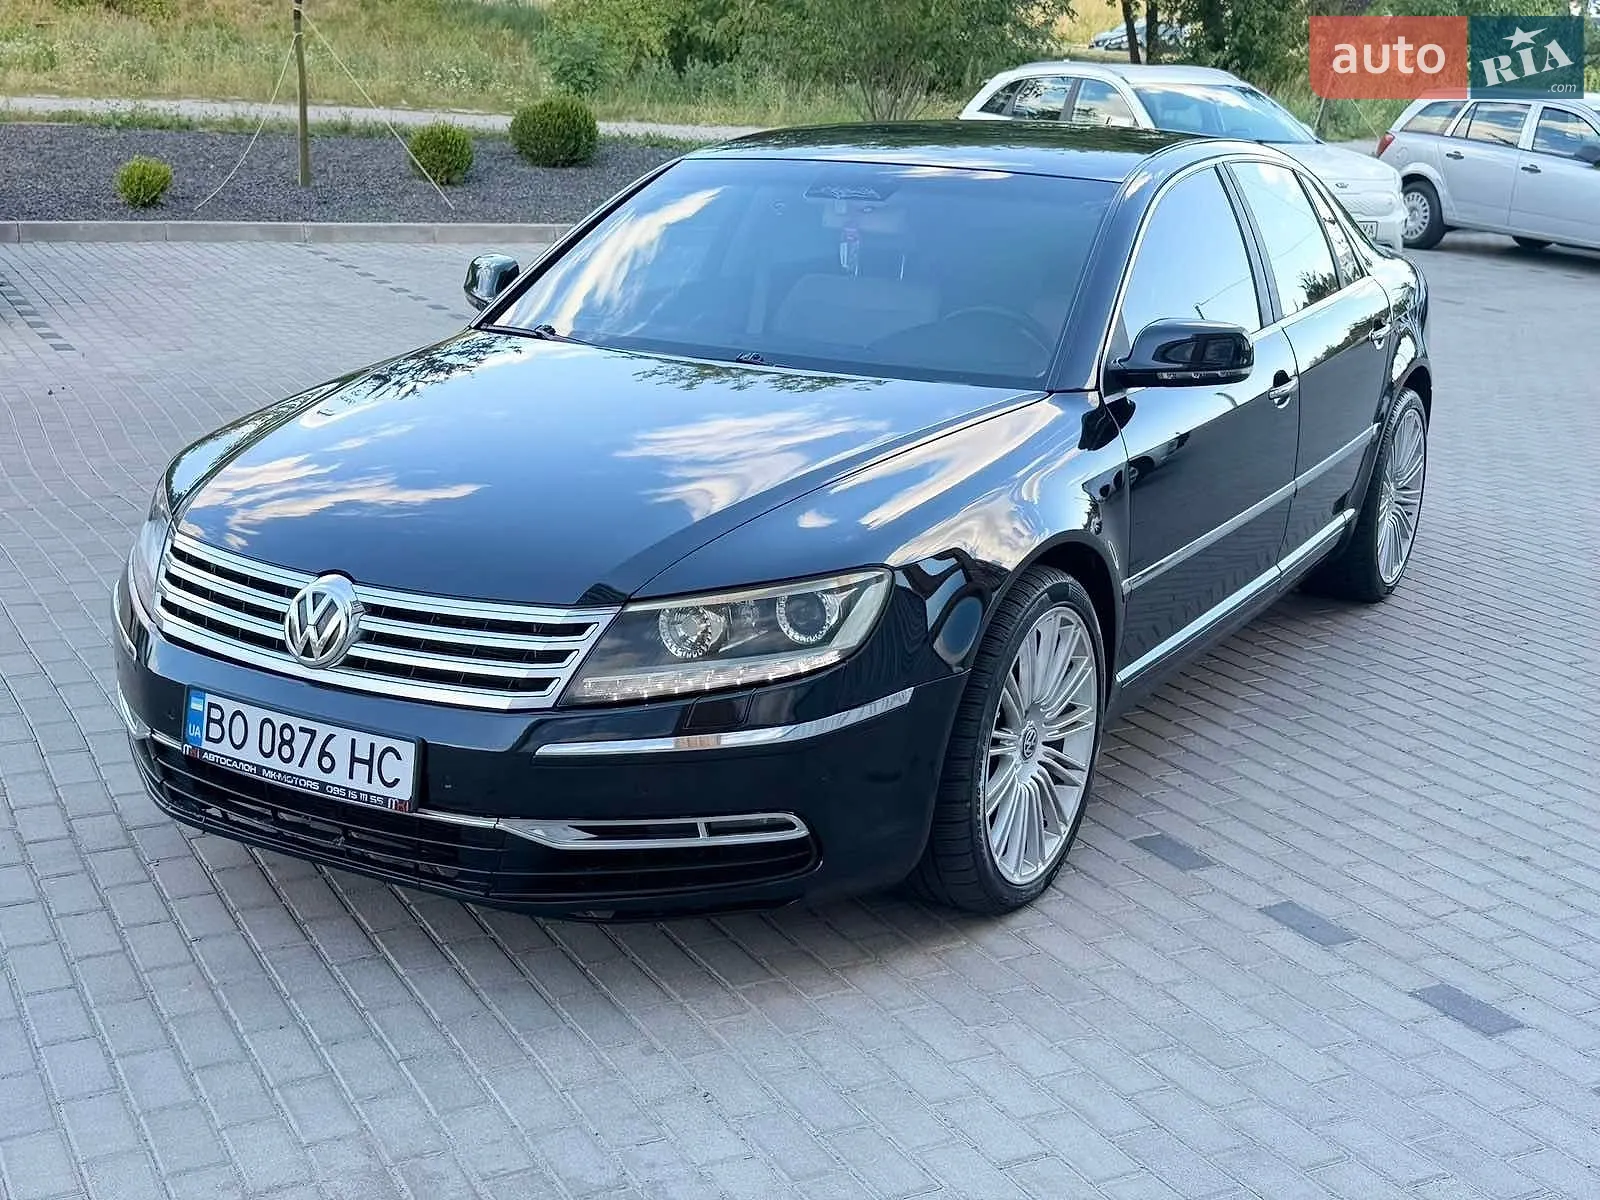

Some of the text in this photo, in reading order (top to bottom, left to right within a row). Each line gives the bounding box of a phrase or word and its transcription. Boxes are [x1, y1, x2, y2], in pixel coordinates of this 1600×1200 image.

[188, 723, 201, 738] UA
[205, 701, 402, 789] BO 0876 HC
[202, 751, 257, 774] АВТОСАЛОН
[262, 768, 320, 790] MK-MOTORS
